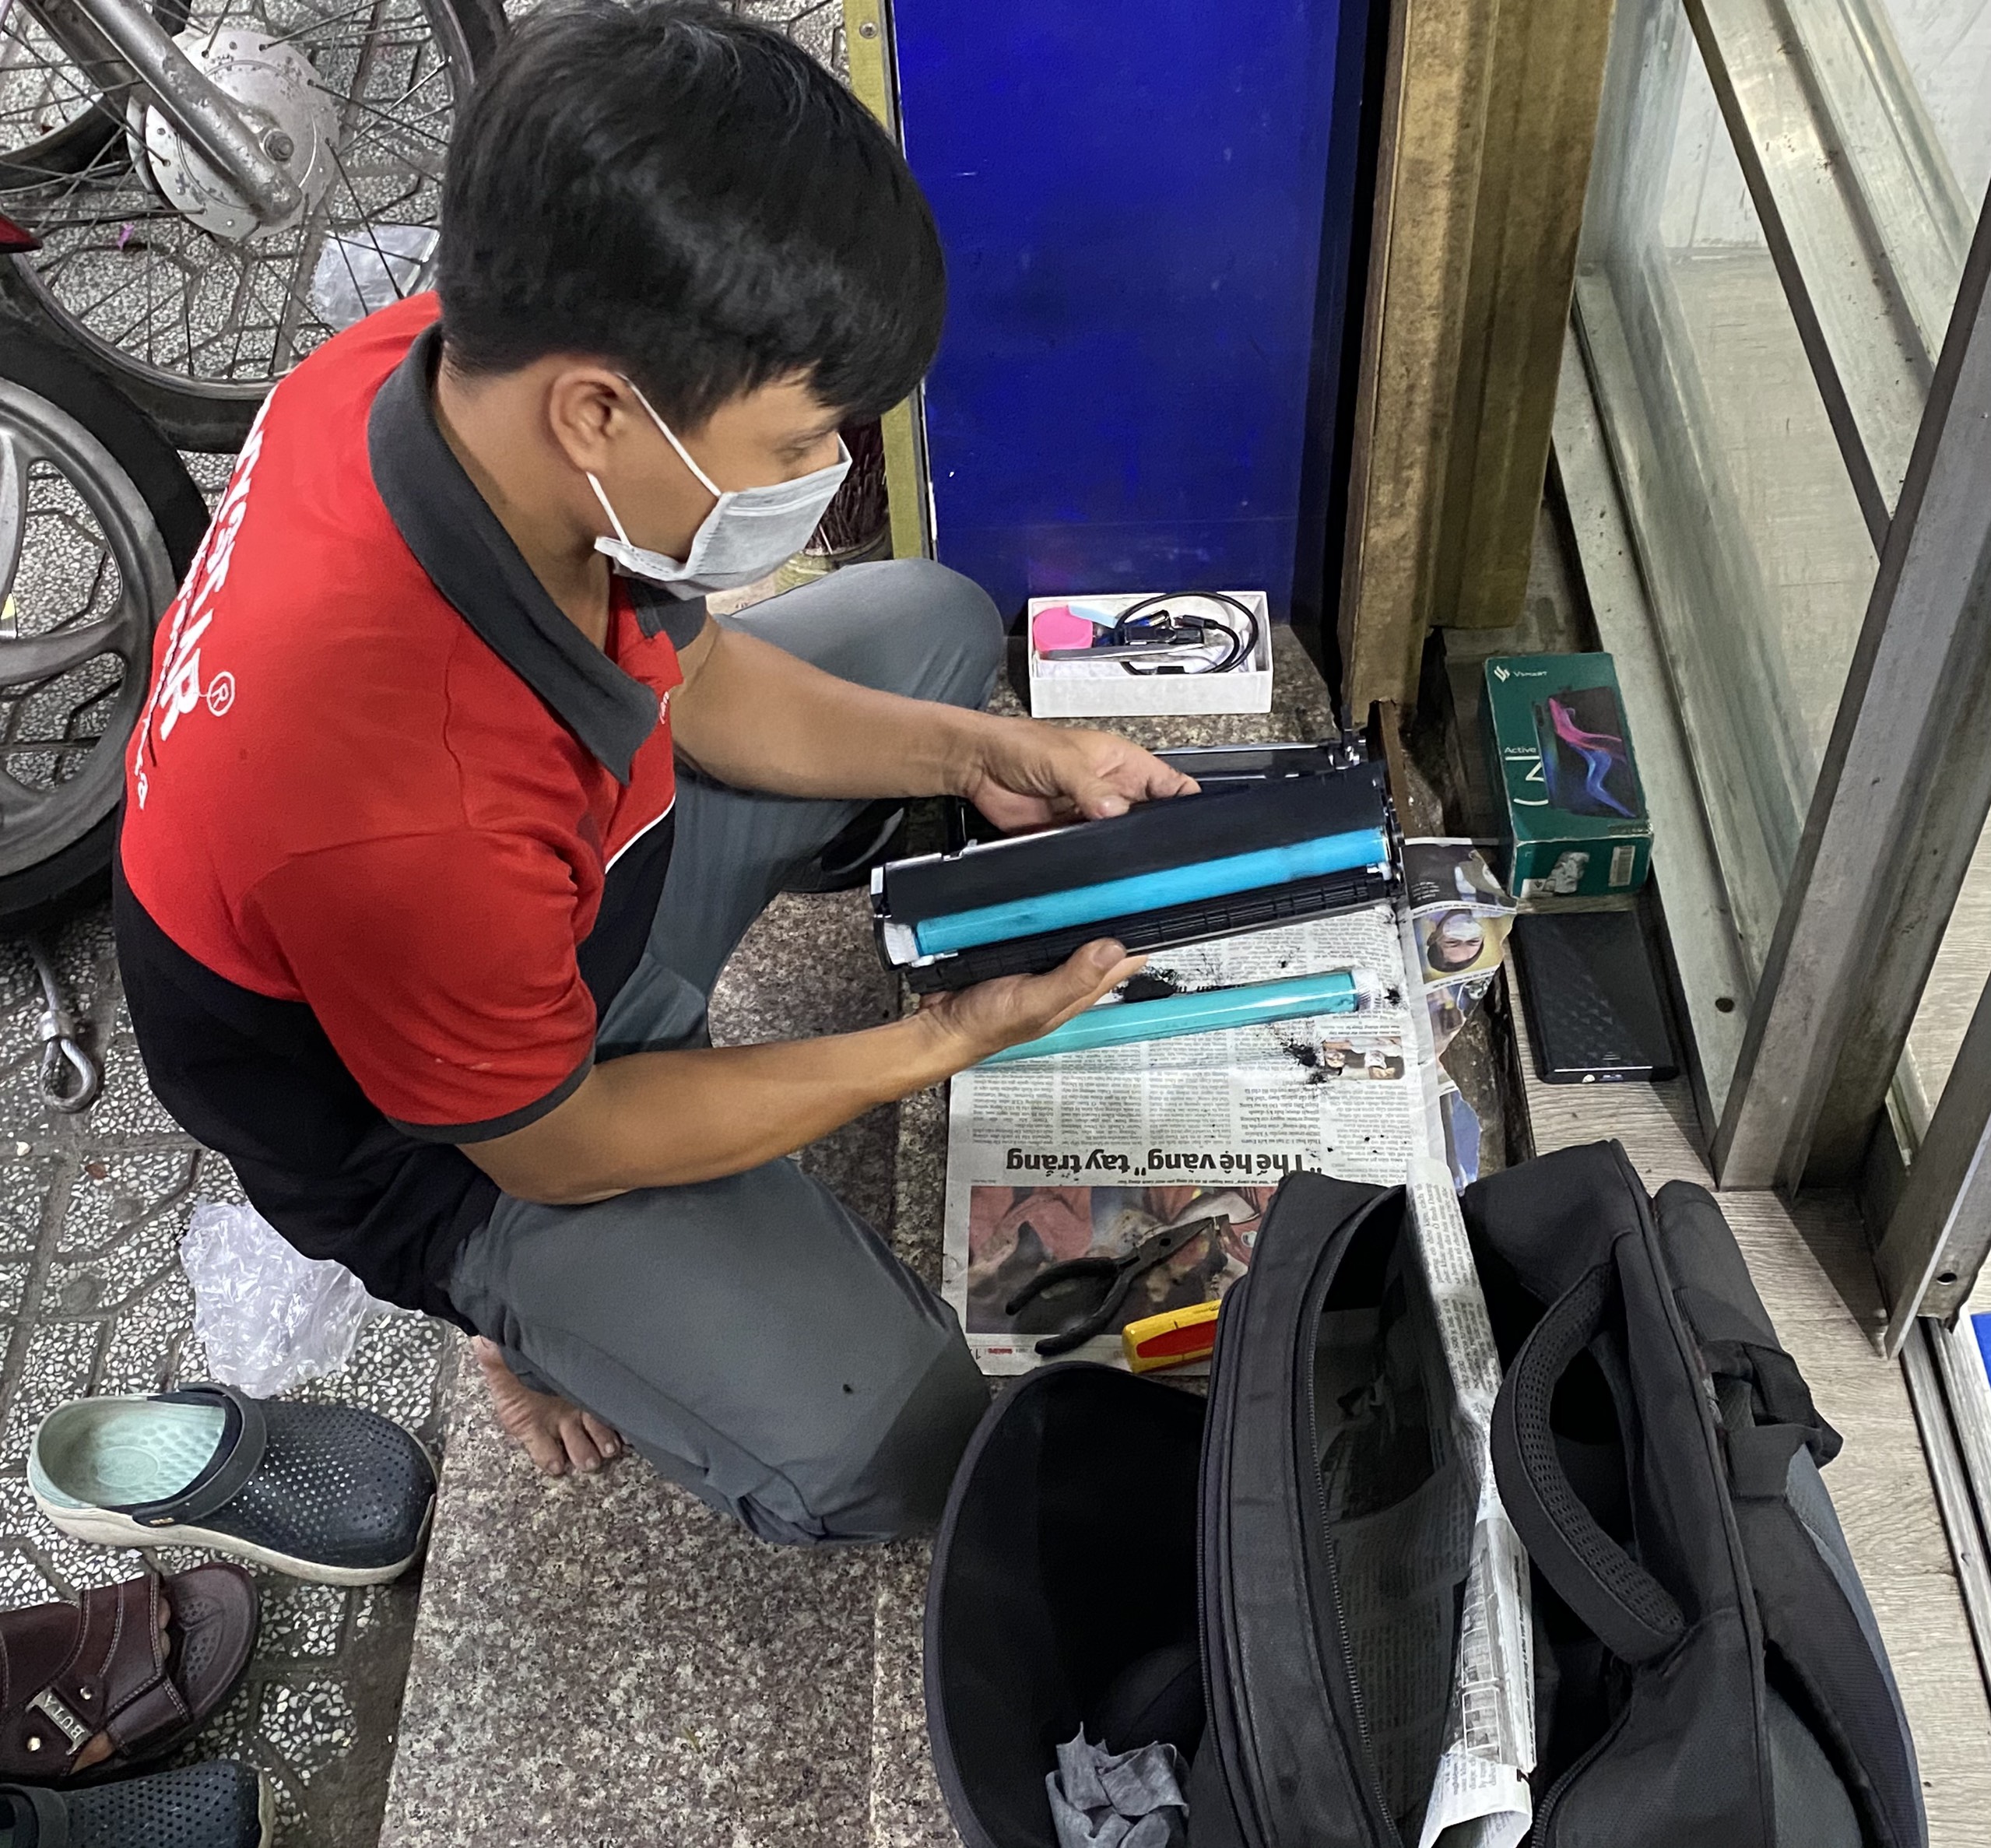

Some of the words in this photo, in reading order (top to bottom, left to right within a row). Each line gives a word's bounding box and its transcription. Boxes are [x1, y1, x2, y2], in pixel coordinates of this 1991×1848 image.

[1006, 1147, 1082, 1177] trắng
[1085, 1149, 1130, 1174] tay
[1133, 1147, 1216, 1175] vàng"
[1219, 1151, 1252, 1175] hệ
